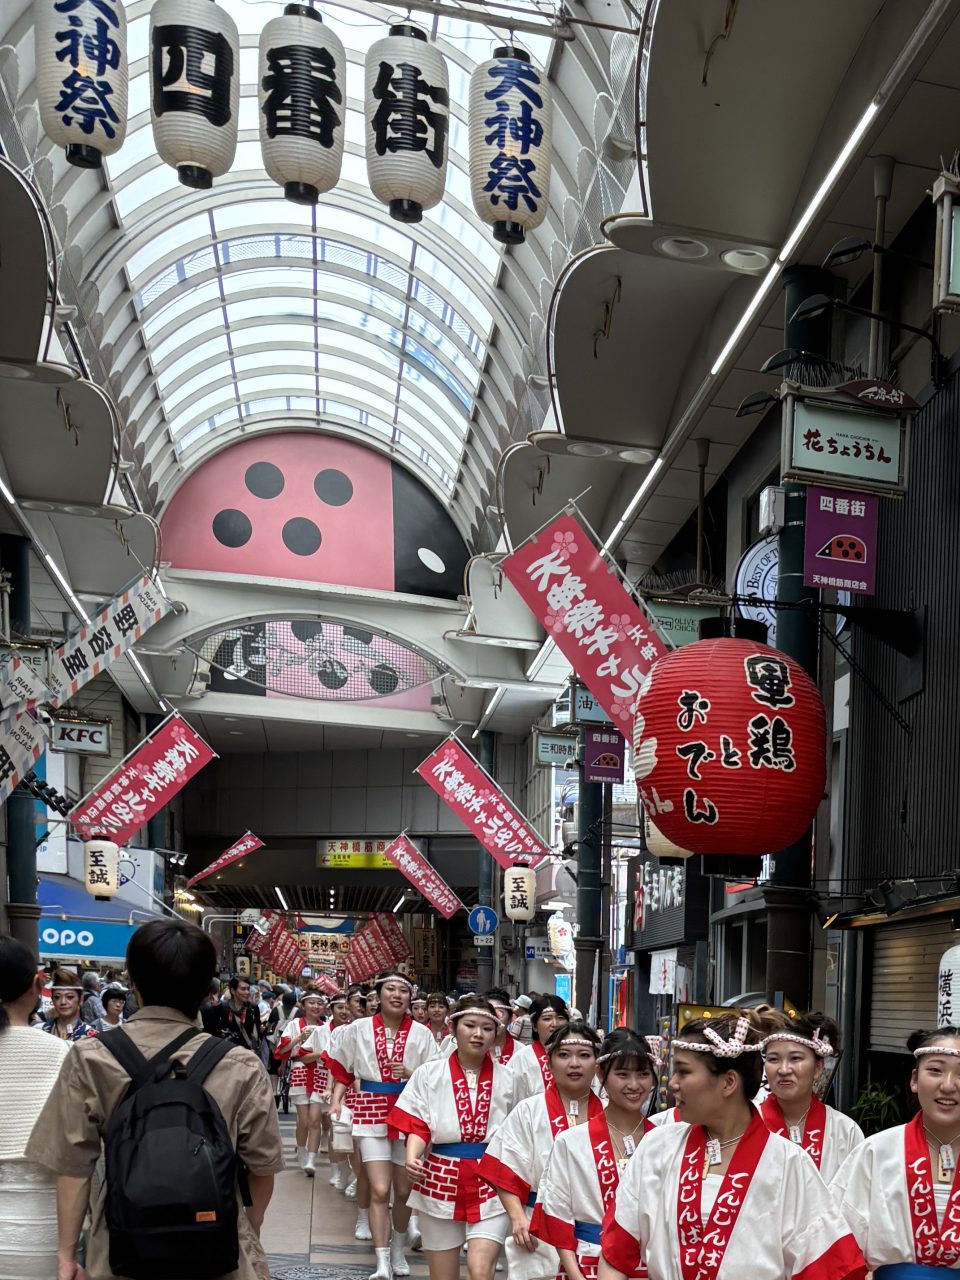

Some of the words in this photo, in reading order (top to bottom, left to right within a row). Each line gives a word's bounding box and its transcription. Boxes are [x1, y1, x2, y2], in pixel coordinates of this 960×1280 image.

[483, 59, 543, 212] 天神祭
[802, 428, 892, 464] 花ちょうちん
[820, 495, 865, 517] 四番街
[58, 727, 103, 744] KFC
[593, 734, 619, 744] 四番街
[719, 734, 742, 769] と
[676, 690, 720, 825] おでん
[88, 850, 110, 886] 至誠
[510, 876, 529, 910] 至誠
[475, 937, 493, 945] T-22
[938, 968, 954, 1025] 横浜
